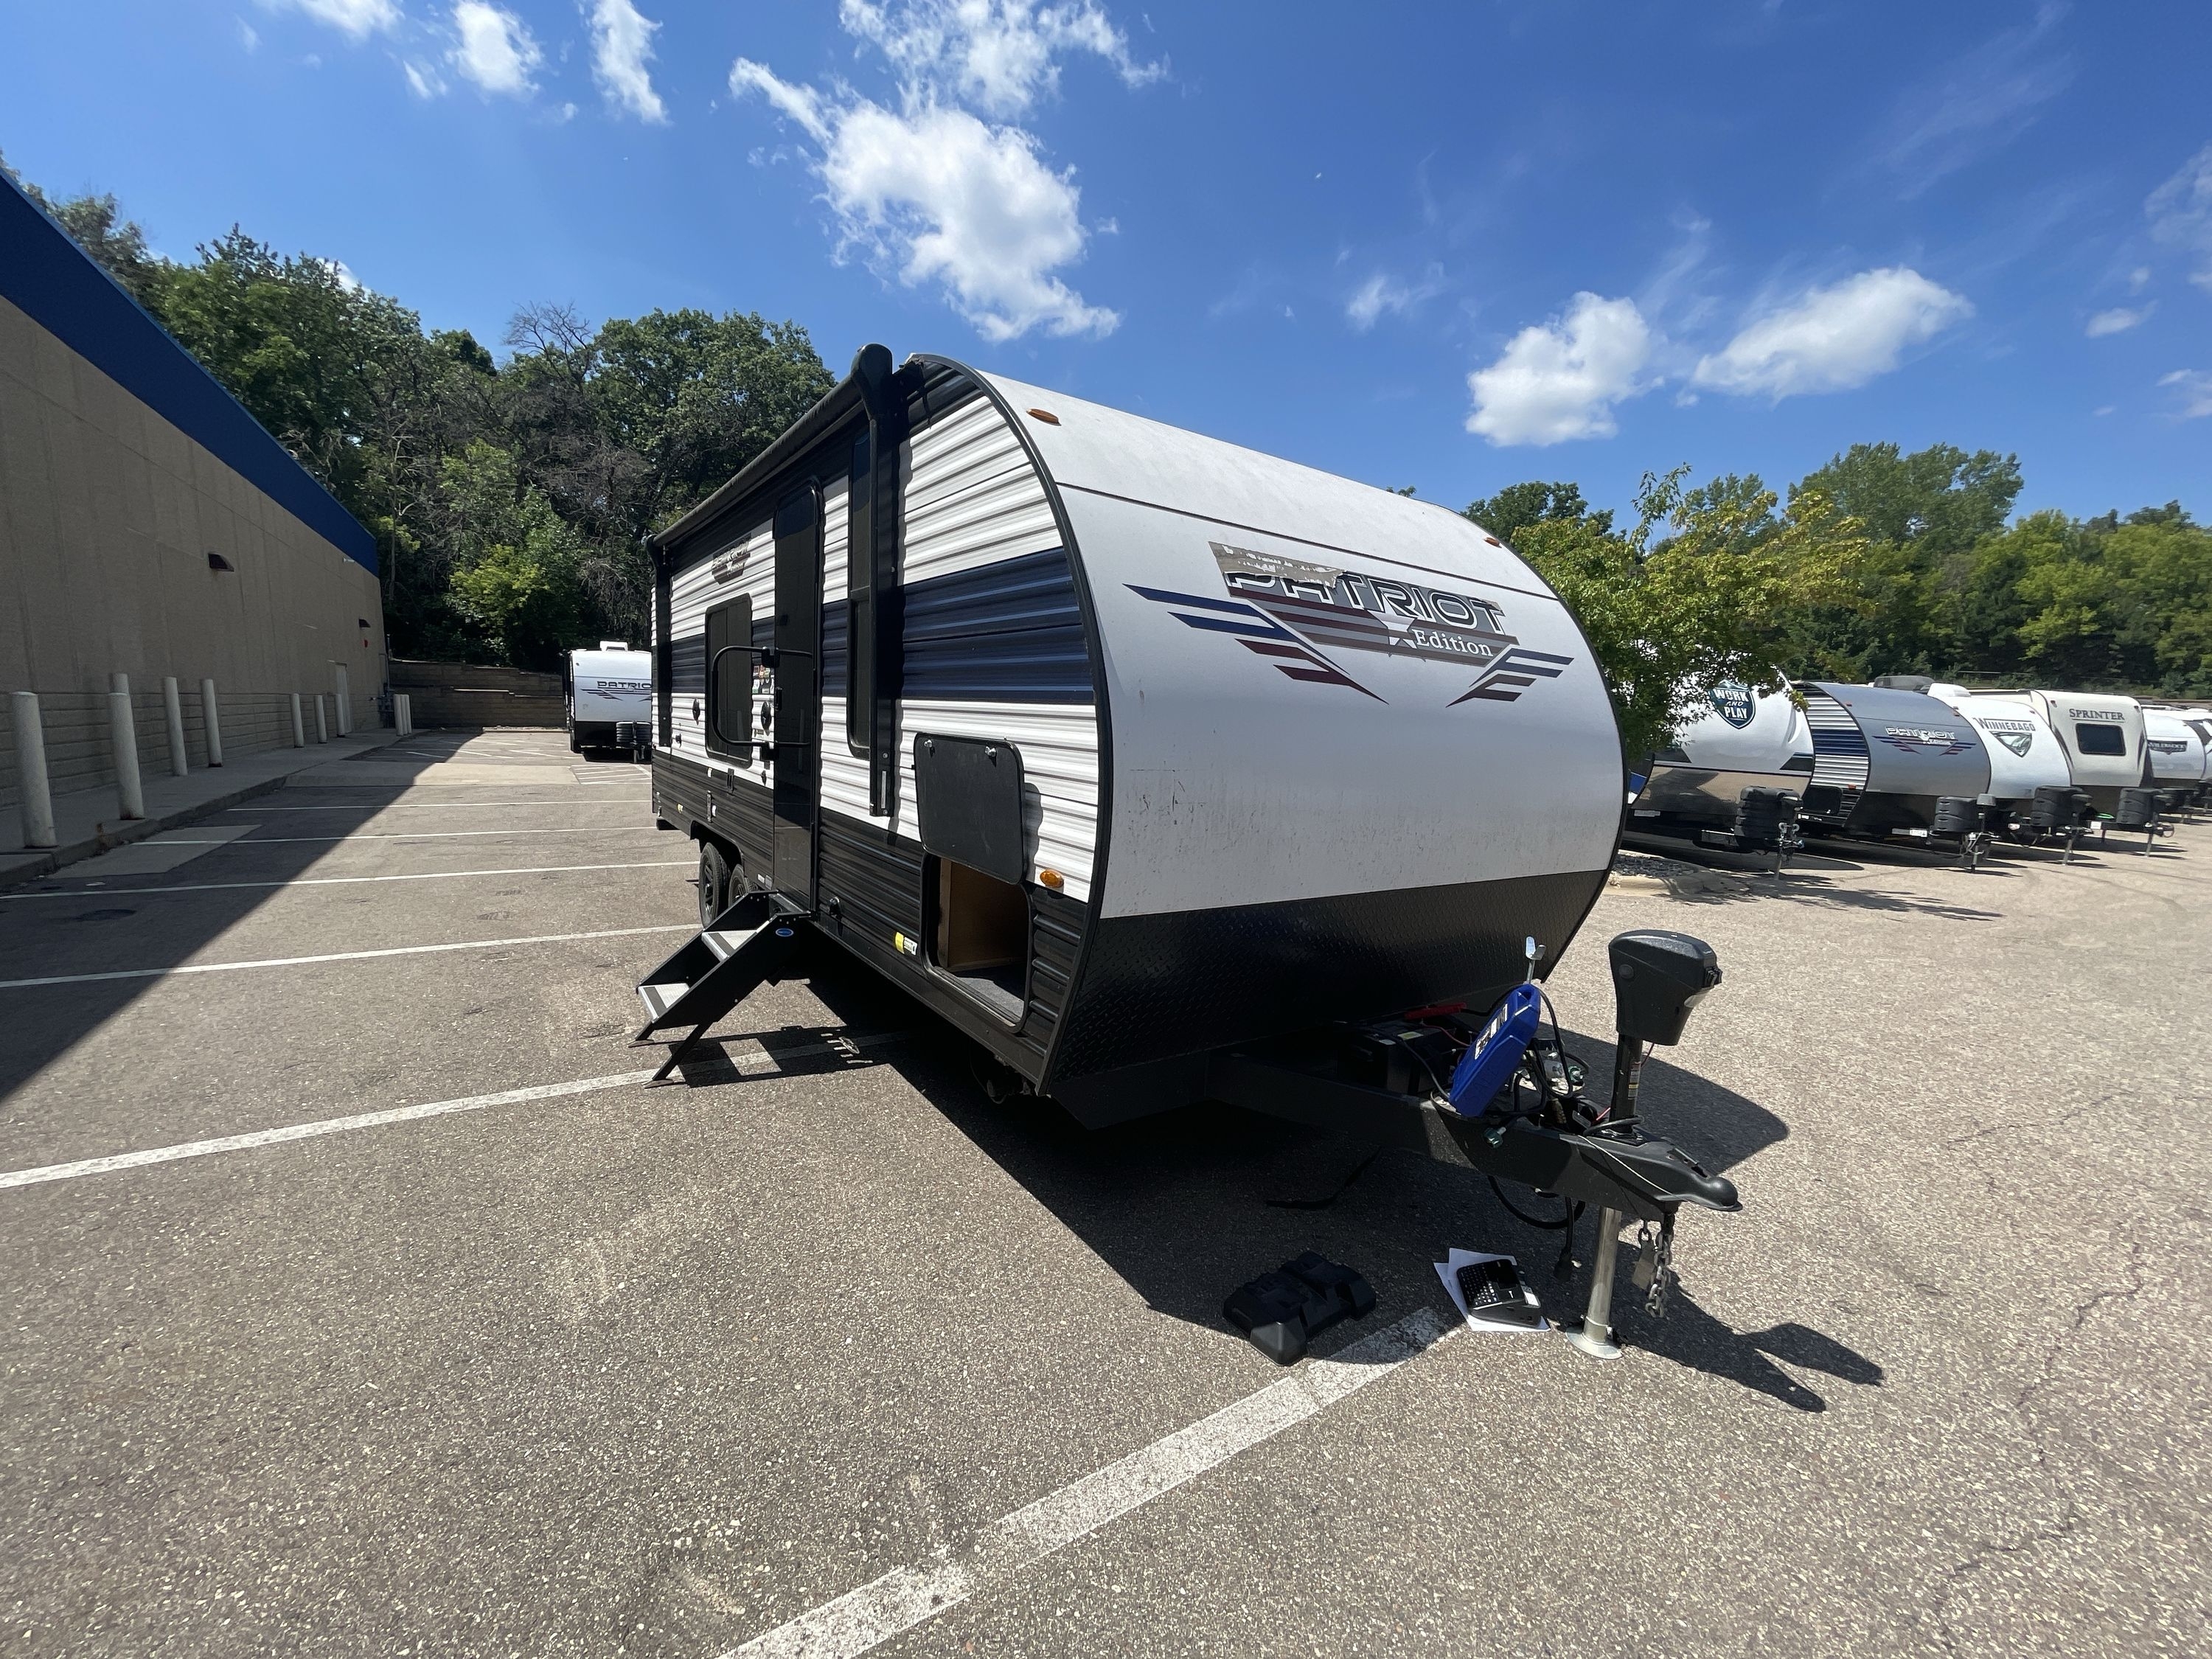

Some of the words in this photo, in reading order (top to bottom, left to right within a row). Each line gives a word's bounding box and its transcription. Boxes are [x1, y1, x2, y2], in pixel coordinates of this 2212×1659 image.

[1411, 628, 1494, 657] Edition
[597, 681, 653, 689] PATRIO
[1713, 689, 1749, 702] WORK
[1724, 706, 1747, 719] PLAY
[2069, 709, 2125, 720] SPRINTER
[1972, 717, 2036, 731] WINNEBAGO
[1885, 726, 1955, 740] PATRIOT
